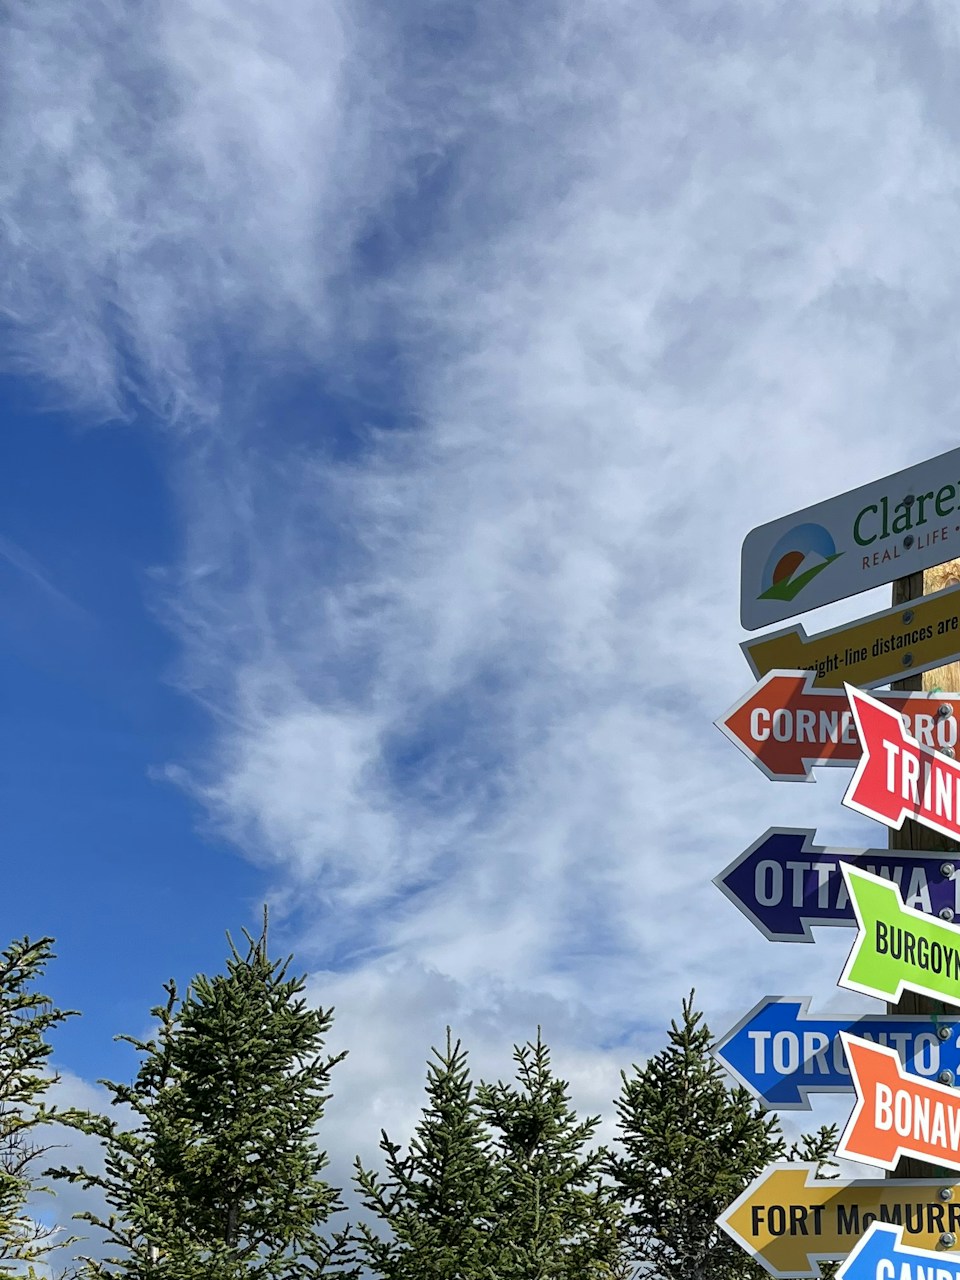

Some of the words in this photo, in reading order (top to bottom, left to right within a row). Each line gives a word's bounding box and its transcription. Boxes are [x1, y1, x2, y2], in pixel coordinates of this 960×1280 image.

[862, 546, 901, 570] REAL
[917, 530, 949, 550] LIFE
[797, 648, 868, 678] ight-line
[872, 625, 933, 657] distances
[938, 613, 959, 634] are
[750, 707, 857, 745] CORNE
[751, 1204, 825, 1236] FORT
